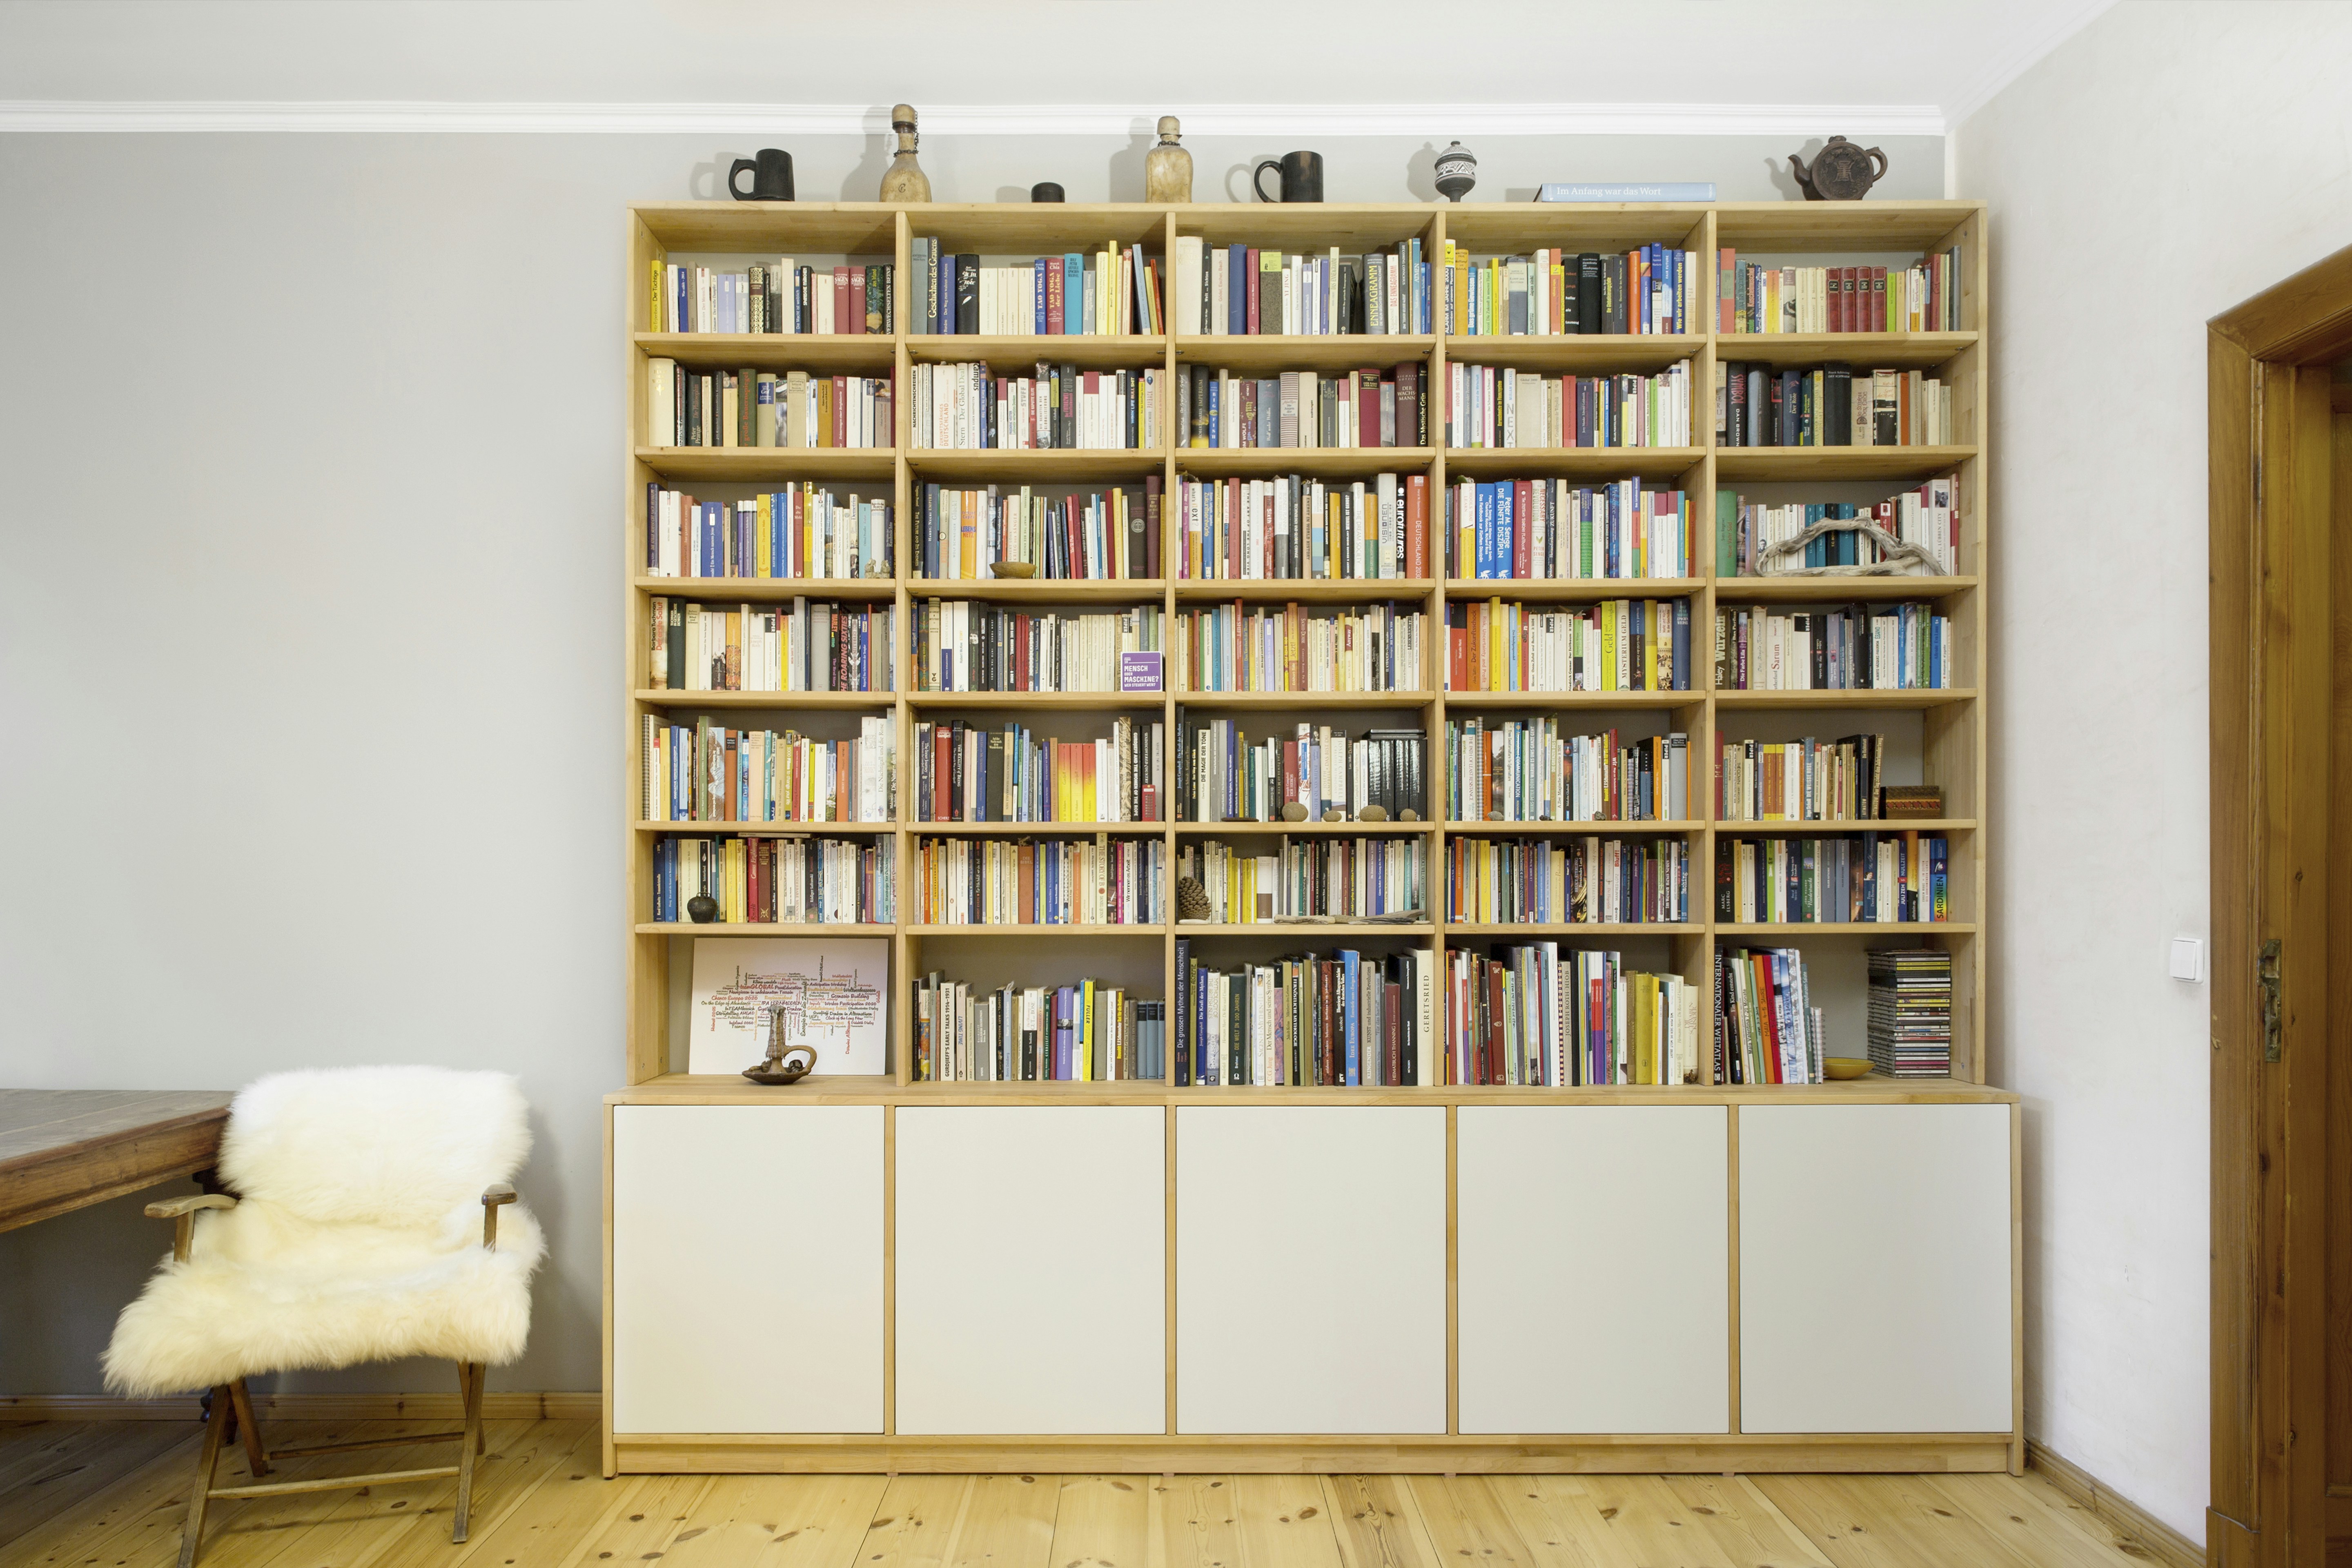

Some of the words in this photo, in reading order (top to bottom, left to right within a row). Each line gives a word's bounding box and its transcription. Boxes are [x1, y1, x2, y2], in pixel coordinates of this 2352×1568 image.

[1557, 187, 1569, 195] Im
[1571, 187, 1603, 197] Anfang
[1624, 187, 1638, 195] das
[1639, 187, 1661, 195] Wort
[928, 239, 937, 266] Grauens
[928, 278, 938, 318] Geschichten
[1369, 265, 1379, 326] ENNEAGRAMM
[1064, 378, 1073, 392] 2013
[1731, 374, 1744, 404] SYMBOL
[1497, 501, 1506, 525] FÜNFTE
[1503, 515, 1510, 524] M.
[1395, 499, 1405, 559] eurofutures
[1604, 634, 1613, 653] Geld
[1714, 615, 1726, 661] Wurzeln
[1771, 644, 1780, 670] Sarum
[1715, 666, 1724, 685] Haley
[1936, 876, 1944, 919] SARDINIEN
